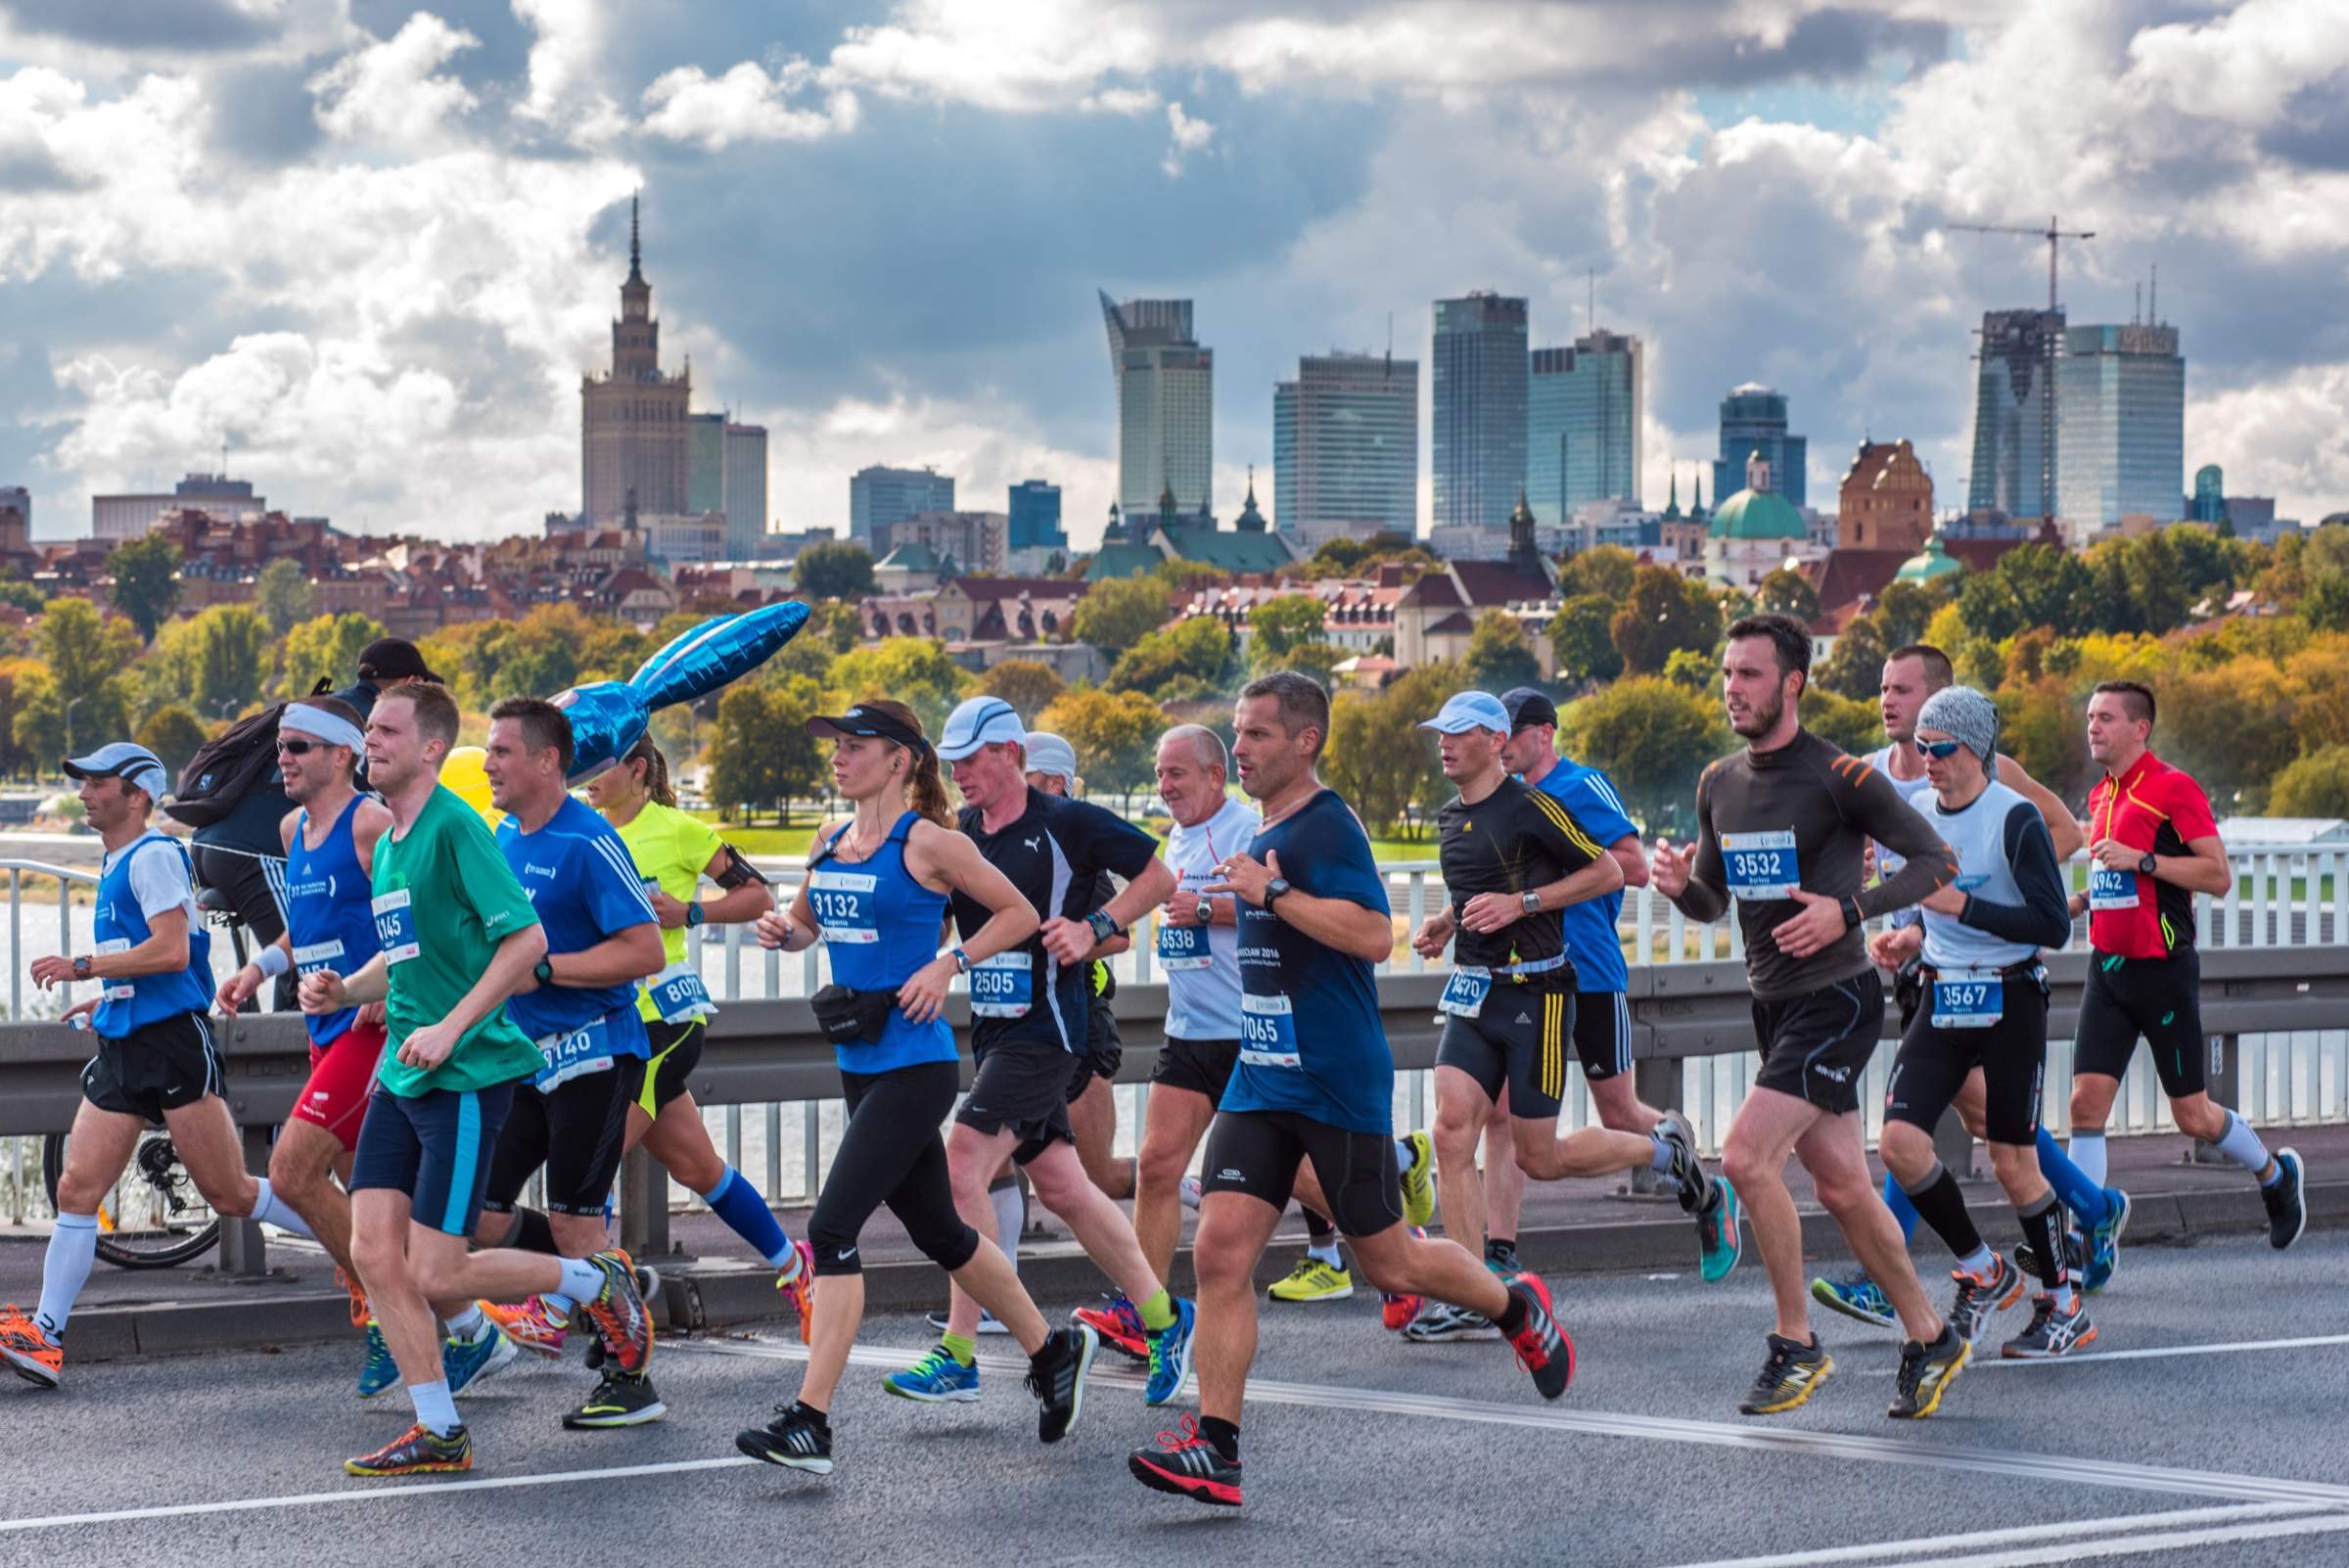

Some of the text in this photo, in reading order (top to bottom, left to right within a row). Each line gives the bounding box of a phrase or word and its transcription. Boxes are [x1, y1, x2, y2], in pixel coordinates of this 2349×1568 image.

[1734, 852, 1781, 876] 3532
[2093, 872, 2123, 891] 4942
[813, 892, 859, 918] 3132
[1162, 930, 1195, 949] 6538
[1262, 947, 1280, 959] 2016
[667, 977, 703, 1003] 8072
[974, 971, 1014, 994] 2505
[1943, 985, 1987, 1007] 3567
[1242, 1015, 1278, 1042] 7065
